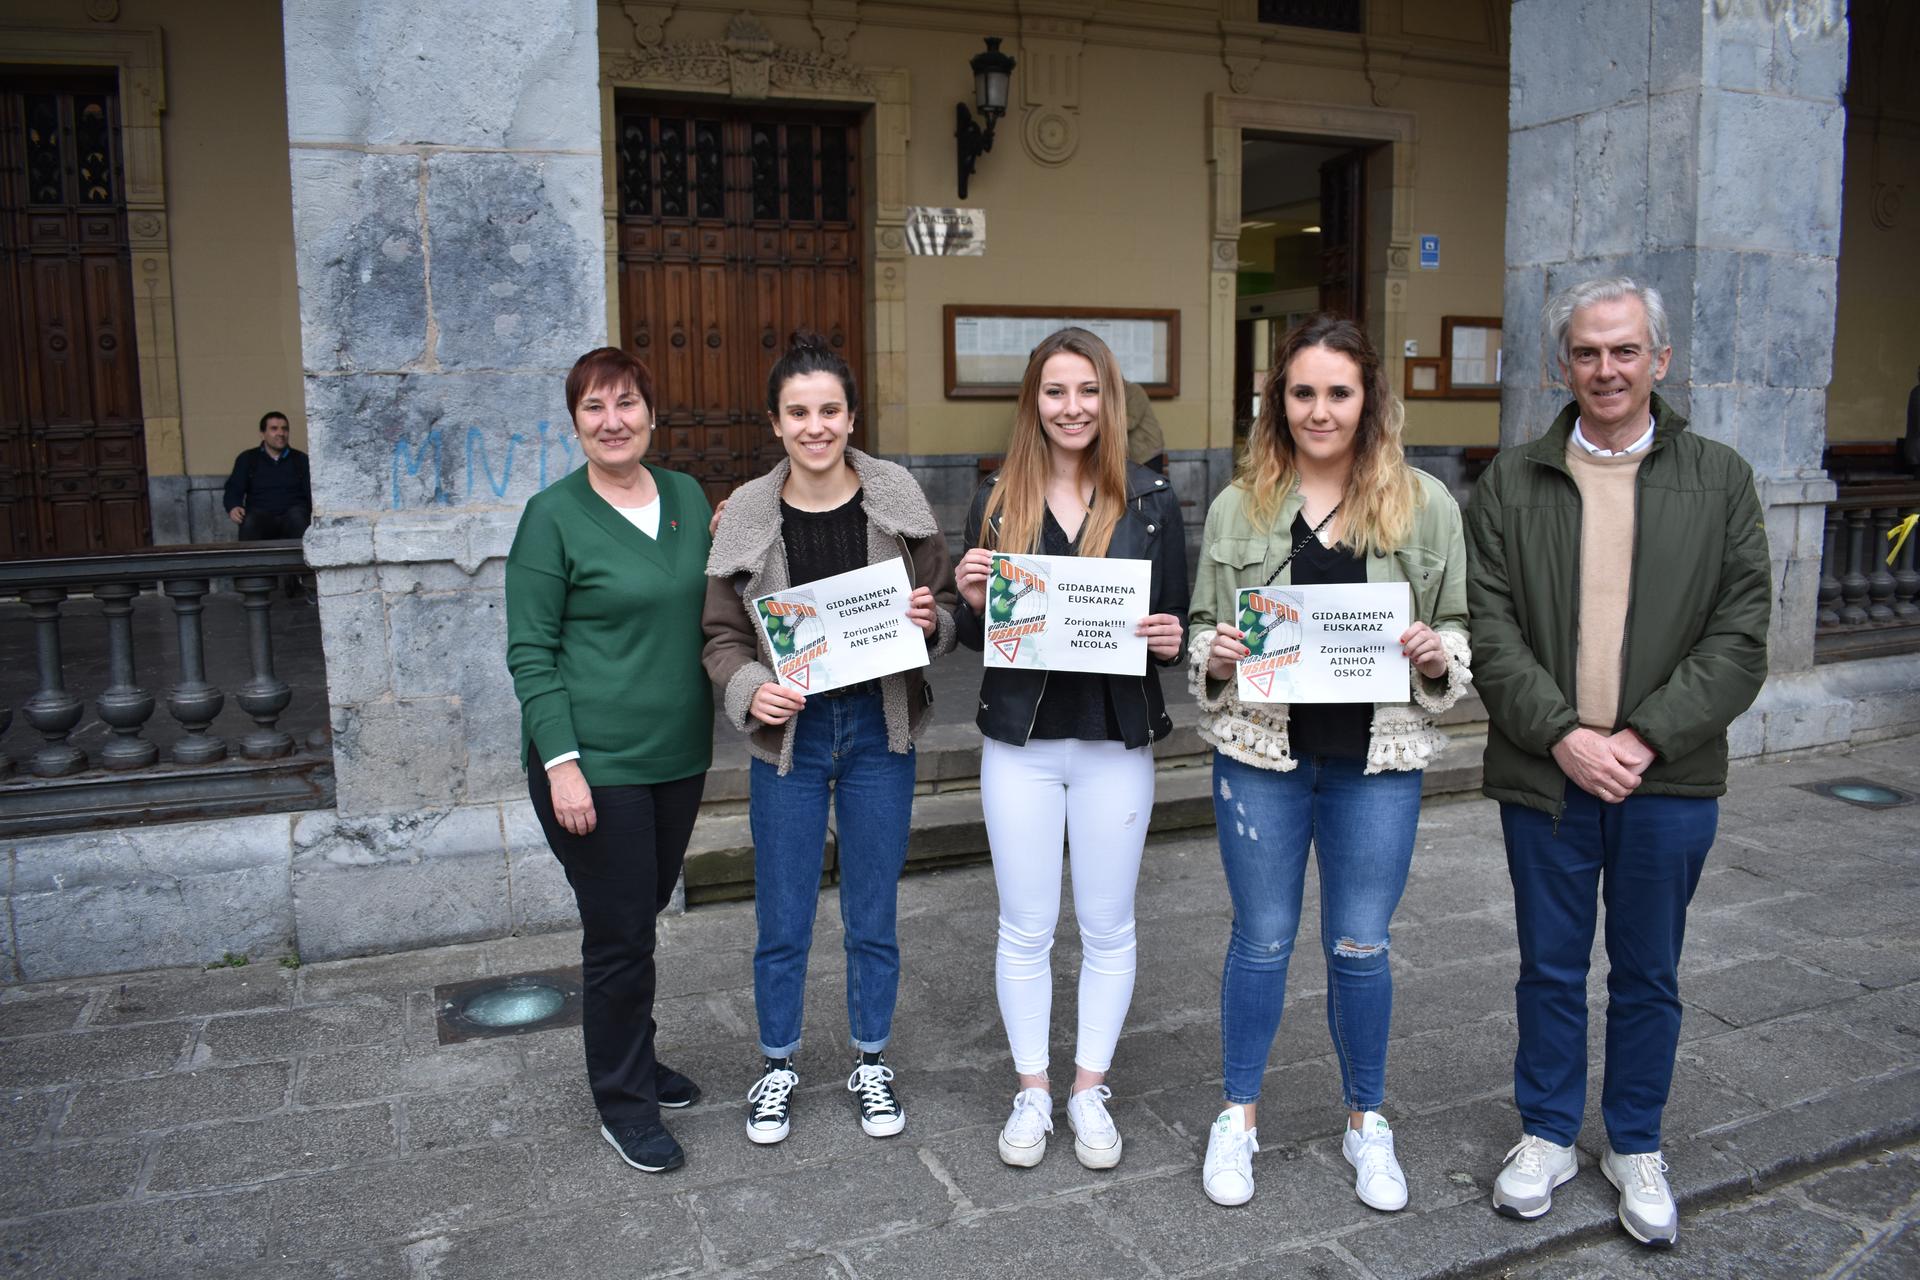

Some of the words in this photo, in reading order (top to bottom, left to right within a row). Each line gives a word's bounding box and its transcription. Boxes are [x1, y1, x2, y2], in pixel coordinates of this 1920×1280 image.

[1058, 583, 1136, 595] GIDABAIMENA
[826, 586, 898, 611] GIDABAIMENA
[1068, 595, 1125, 606] EUSKARAZ
[839, 599, 892, 618] EUSKARAZ
[1311, 611, 1395, 621] GIDABAIMENA
[1064, 617, 1126, 629] Zorionak!!!!
[1323, 623, 1384, 632] EUSKARAZ
[843, 619, 900, 639] Zorionak!!!!
[988, 621, 1047, 641] EUSKARAZ
[1077, 630, 1112, 639] AIORA
[850, 637, 869, 649] ANE
[872, 630, 899, 643] SANZ
[1070, 640, 1119, 650] NICOLAS
[1320, 645, 1386, 654] Zorionak!!!!
[778, 641, 829, 676] EUSKARAZ
[1330, 656, 1376, 665] AINHOA
[1333, 668, 1373, 678] OSKOZ
